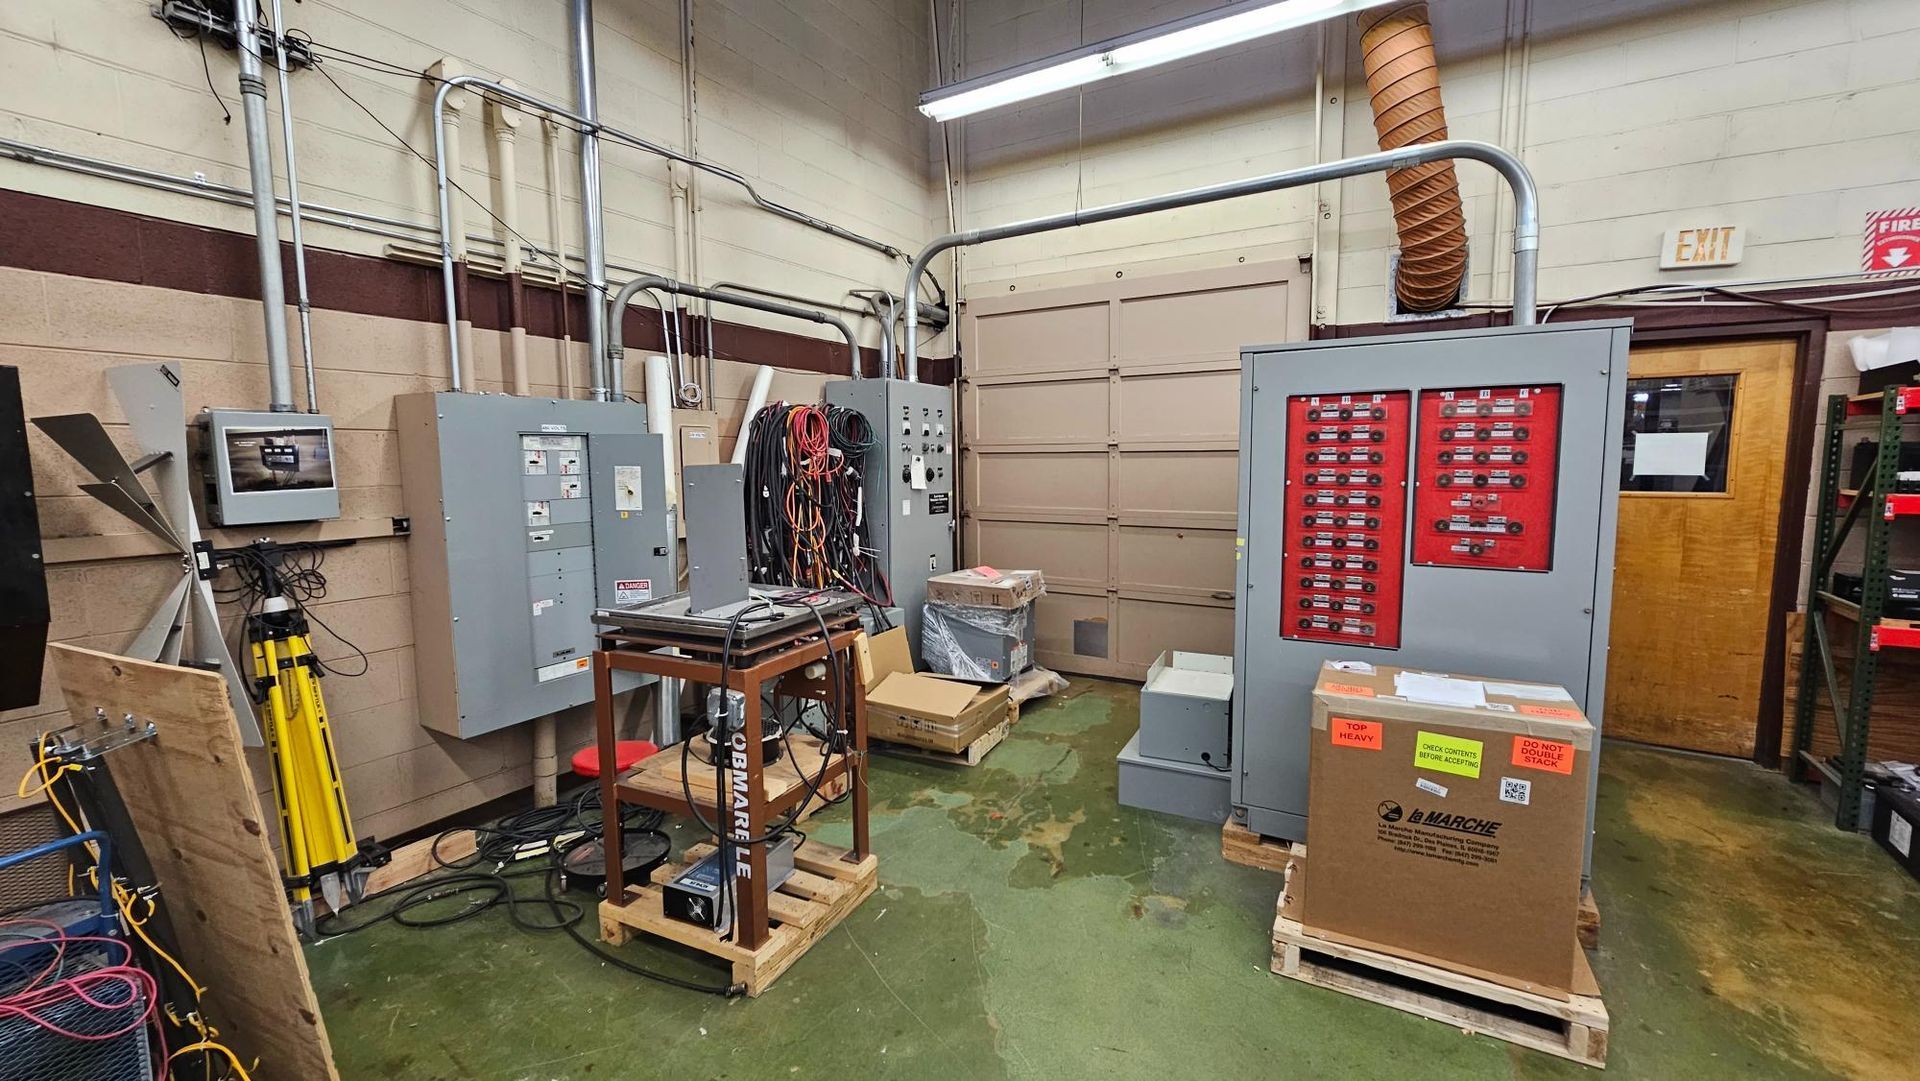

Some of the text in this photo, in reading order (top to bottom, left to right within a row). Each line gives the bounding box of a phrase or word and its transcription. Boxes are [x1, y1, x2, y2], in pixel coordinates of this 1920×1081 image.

[1879, 217, 1920, 234] FIRE
[1675, 226, 1736, 263] EXIT
[625, 582, 648, 590] DANGER
[1346, 722, 1368, 731] TOP
[1339, 732, 1375, 742] HEAVY
[1422, 743, 1478, 760] CHECK CONTENTS
[1523, 740, 1565, 753] DO NOT
[1419, 751, 1479, 769] BEFORE ACCEPTING
[1521, 748, 1564, 761] DOUBLE
[1524, 756, 1558, 768] STACK
[1424, 811, 1503, 835] MARCHE
[1389, 824, 1413, 834] Marche
[1414, 829, 1464, 845] Manufacturing
[1466, 838, 1500, 850] Company
